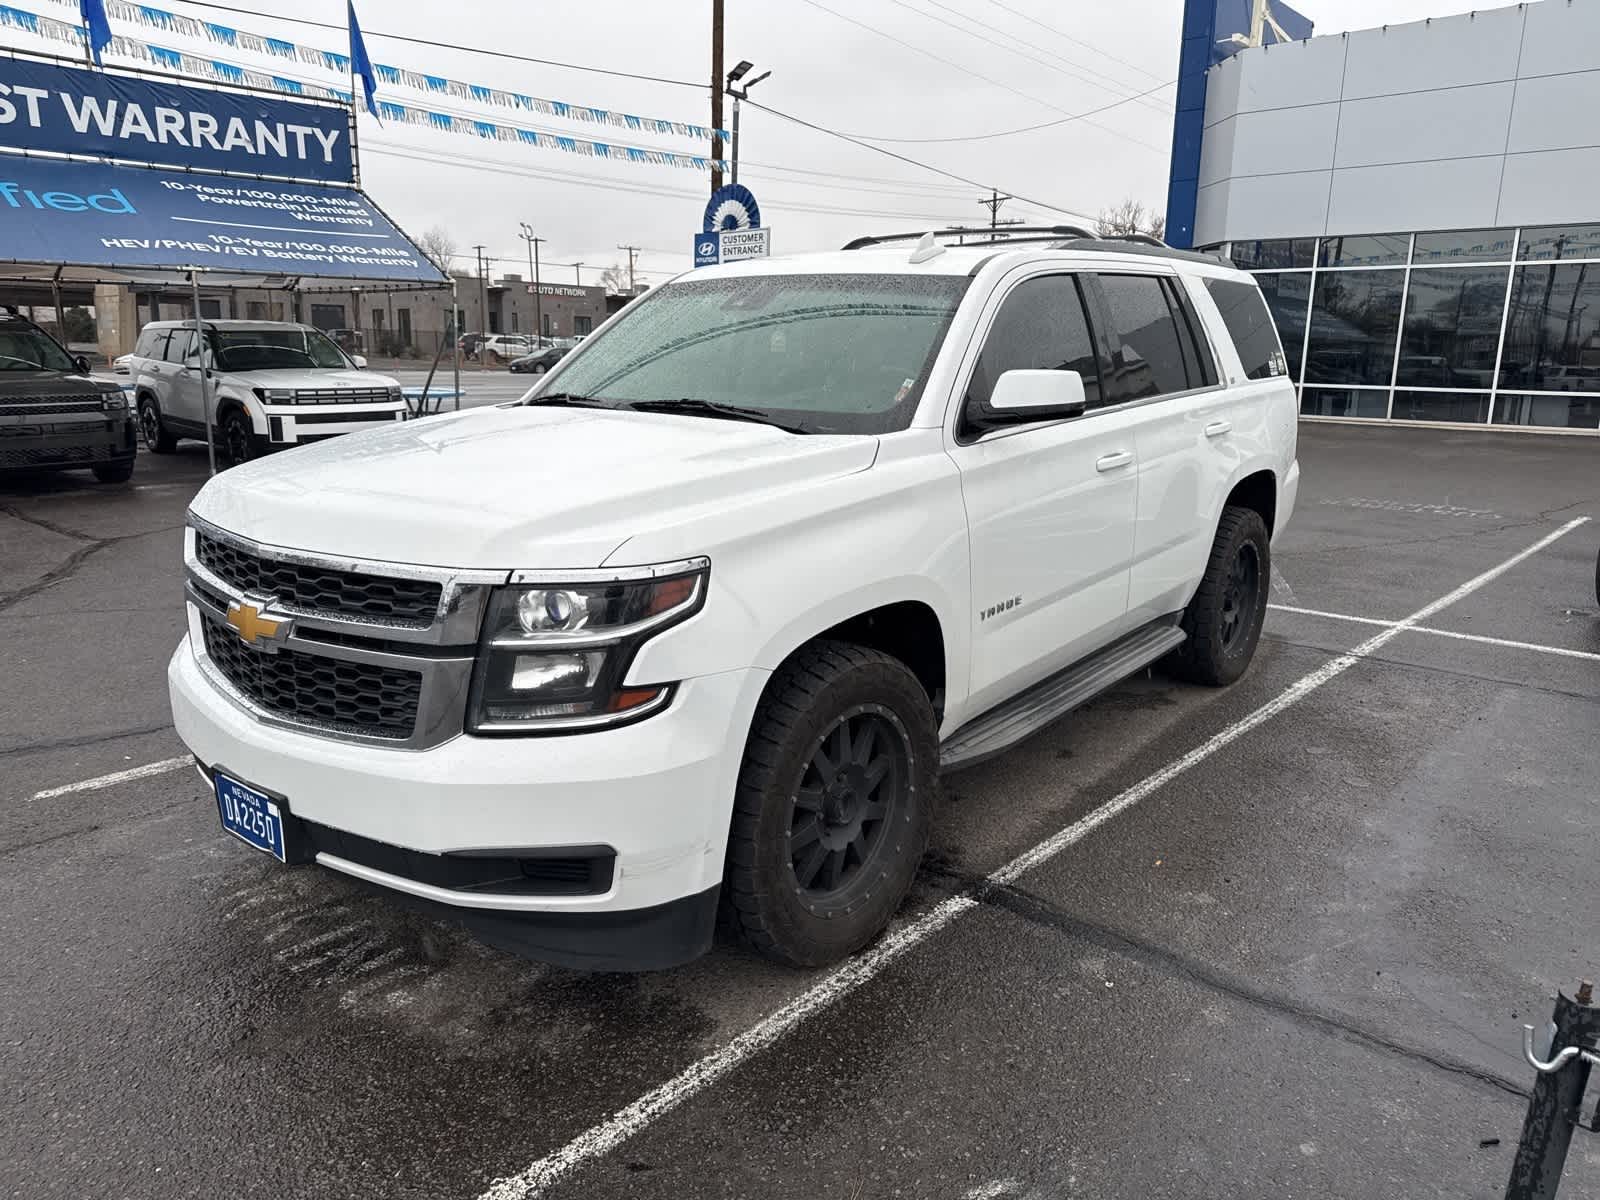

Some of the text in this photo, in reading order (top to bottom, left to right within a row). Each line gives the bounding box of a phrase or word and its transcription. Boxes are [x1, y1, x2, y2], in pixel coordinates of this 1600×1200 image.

[59, 92, 340, 162] WARRANTY
[160, 180, 360, 208] 10-Year/100,000-Mile
[196, 194, 369, 217] Powertrain Limited
[290, 211, 374, 227] Warranty
[208, 234, 410, 257] 10-Year/100,000-Mile
[722, 233, 764, 244] CUSTOMER
[262, 248, 334, 264] Battery
[332, 252, 419, 268] Warranty
[722, 244, 763, 256] ENTRANCE
[534, 285, 586, 297] UTO NETWORK
[980, 595, 1022, 621] TAHOE
[232, 786, 261, 808] NEVADA
